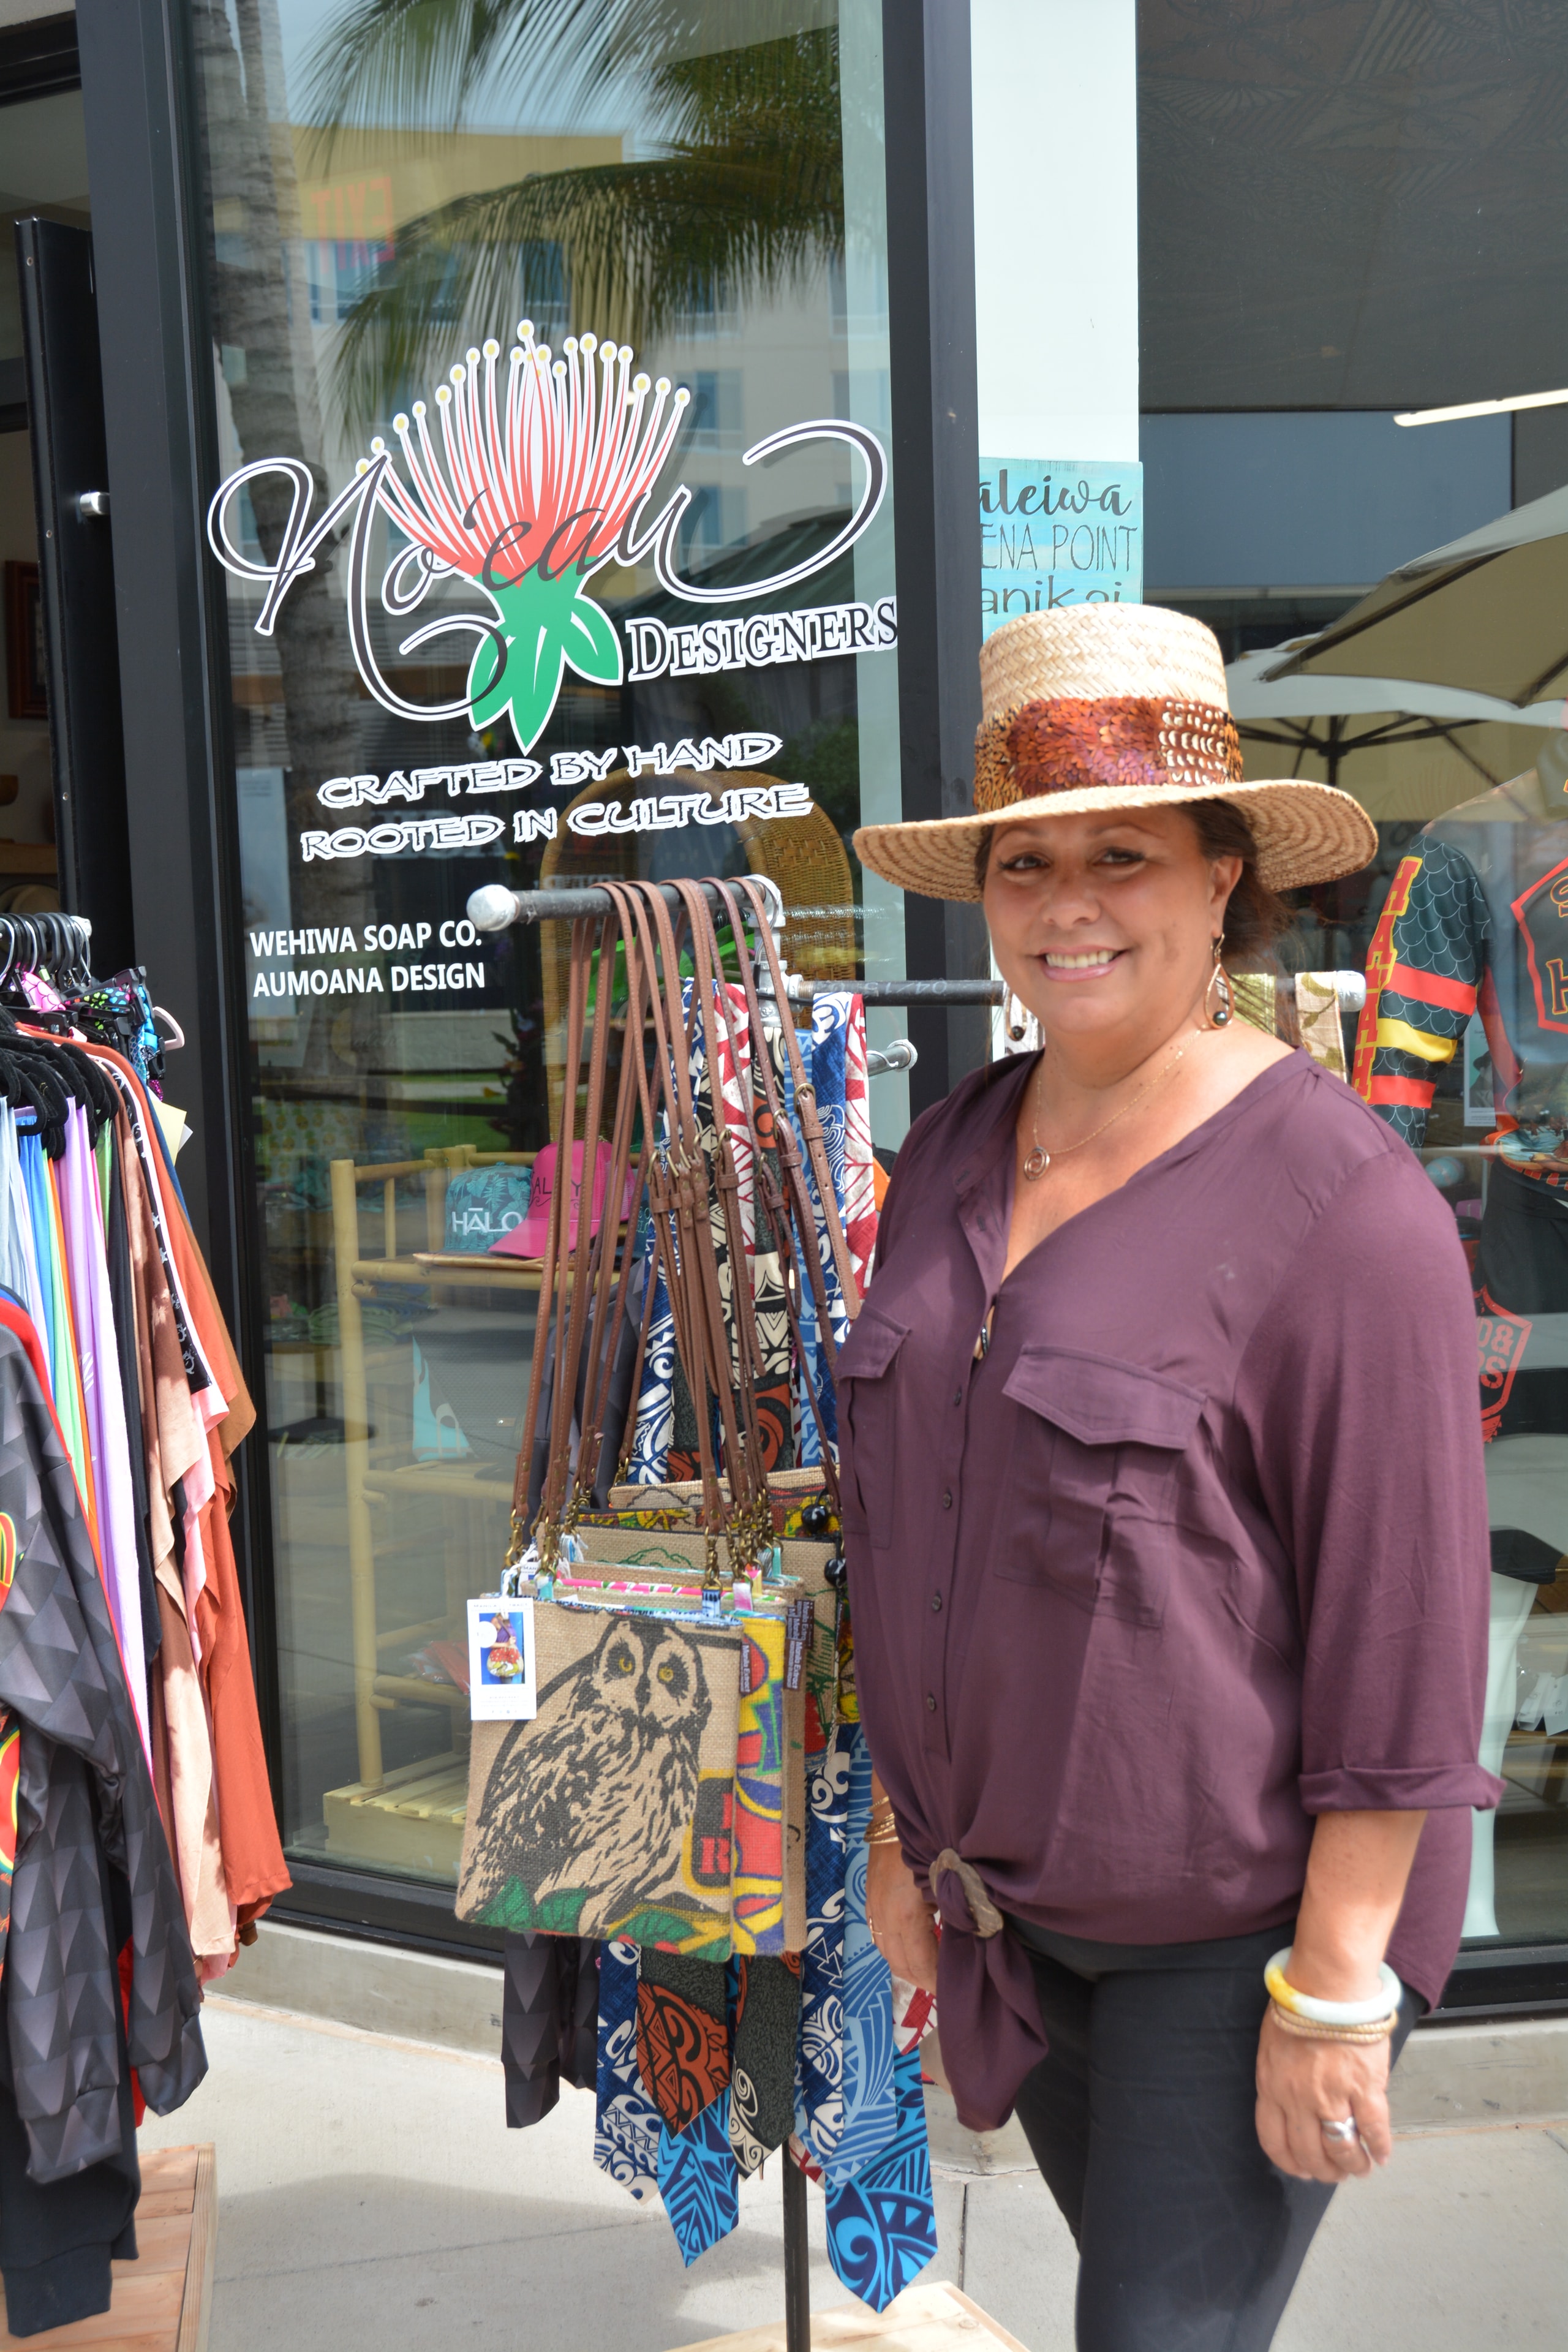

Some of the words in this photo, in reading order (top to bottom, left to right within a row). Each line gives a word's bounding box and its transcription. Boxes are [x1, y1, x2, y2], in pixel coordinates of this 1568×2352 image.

[1052, 524, 1137, 572] POINT
[625, 597, 897, 681] DESIGNERS
[317, 758, 541, 809] CRAFTED
[551, 748, 617, 786] BY
[627, 732, 783, 777] HAND
[301, 810, 505, 862] ROOTED
[513, 807, 557, 843] IN
[567, 783, 814, 837] CULTURE
[250, 927, 357, 957] WEHIWA
[364, 922, 431, 951] SOAP
[439, 919, 482, 948] CO.
[253, 967, 384, 997] AUMOANA
[391, 962, 485, 992] DESIGN
